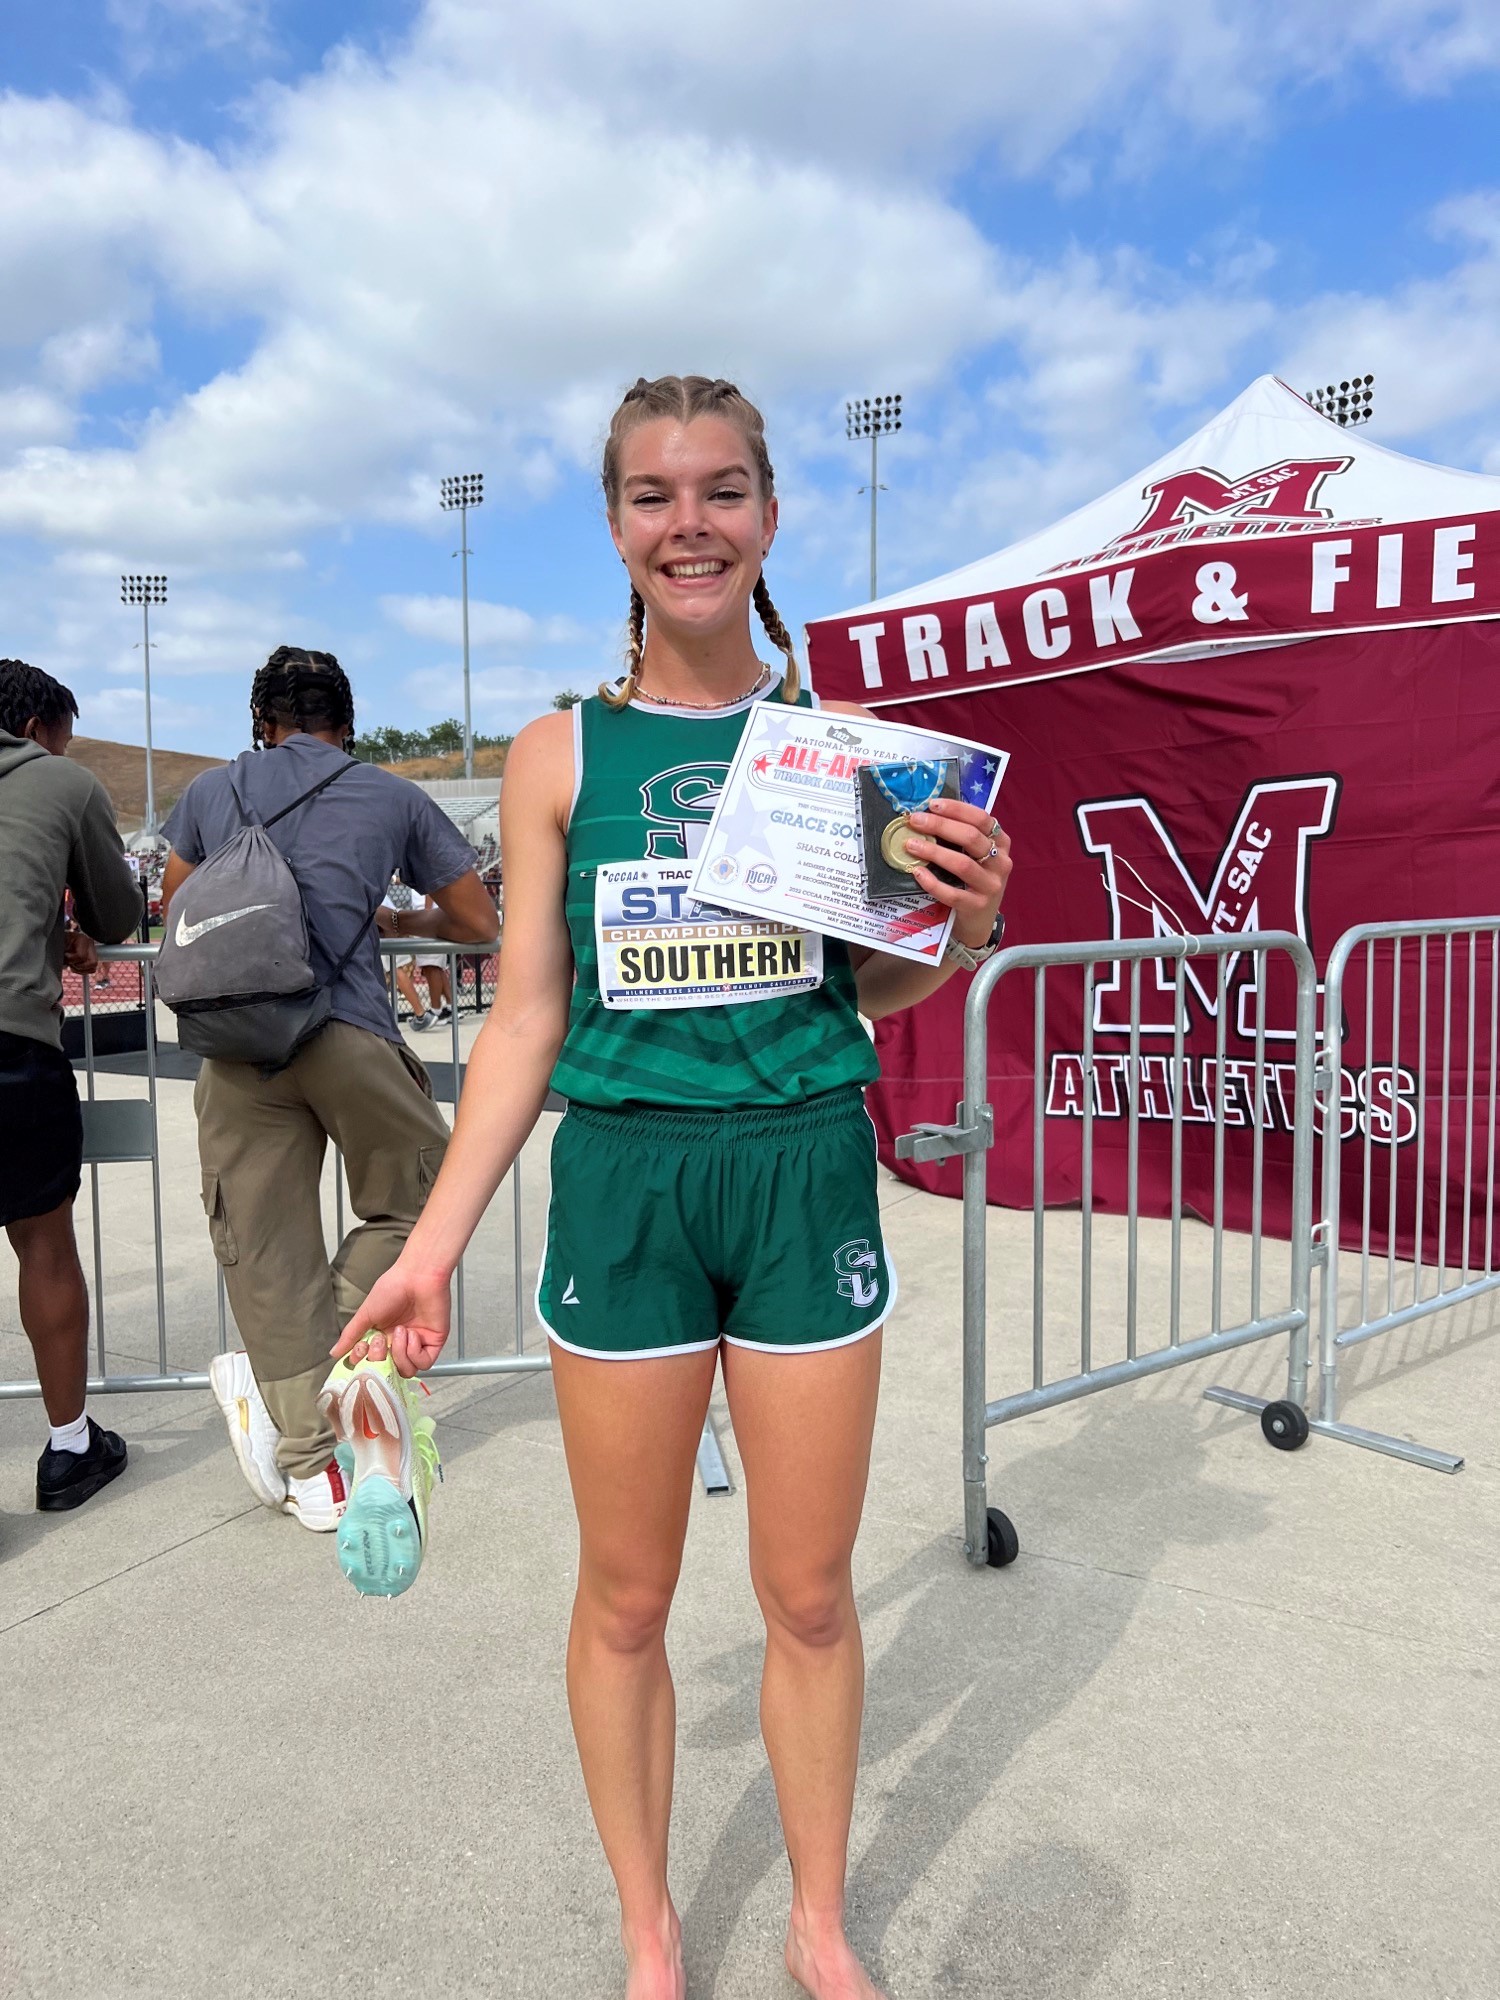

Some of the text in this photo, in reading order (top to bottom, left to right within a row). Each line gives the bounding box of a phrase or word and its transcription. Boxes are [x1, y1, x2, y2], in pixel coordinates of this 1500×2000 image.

[1262, 467, 1300, 487] SAC
[848, 523, 1477, 688] TRACK & FIE
[832, 729, 850, 744] 2022
[794, 736, 844, 751] NATIONAL
[847, 745, 870, 756] TWO
[873, 749, 898, 761] YEAR
[774, 769, 822, 787] TRACK
[770, 810, 828, 833] GRACE
[796, 842, 831, 857] SHASTA
[1227, 821, 1272, 895] SAC
[608, 871, 639, 883] CCCAA
[788, 886, 801, 894] 2022
[823, 895, 841, 904] STATE
[841, 900, 860, 910] TRACK
[861, 906, 873, 914] AND
[874, 910, 890, 918] FIELD
[620, 939, 802, 984] SOUTHERN
